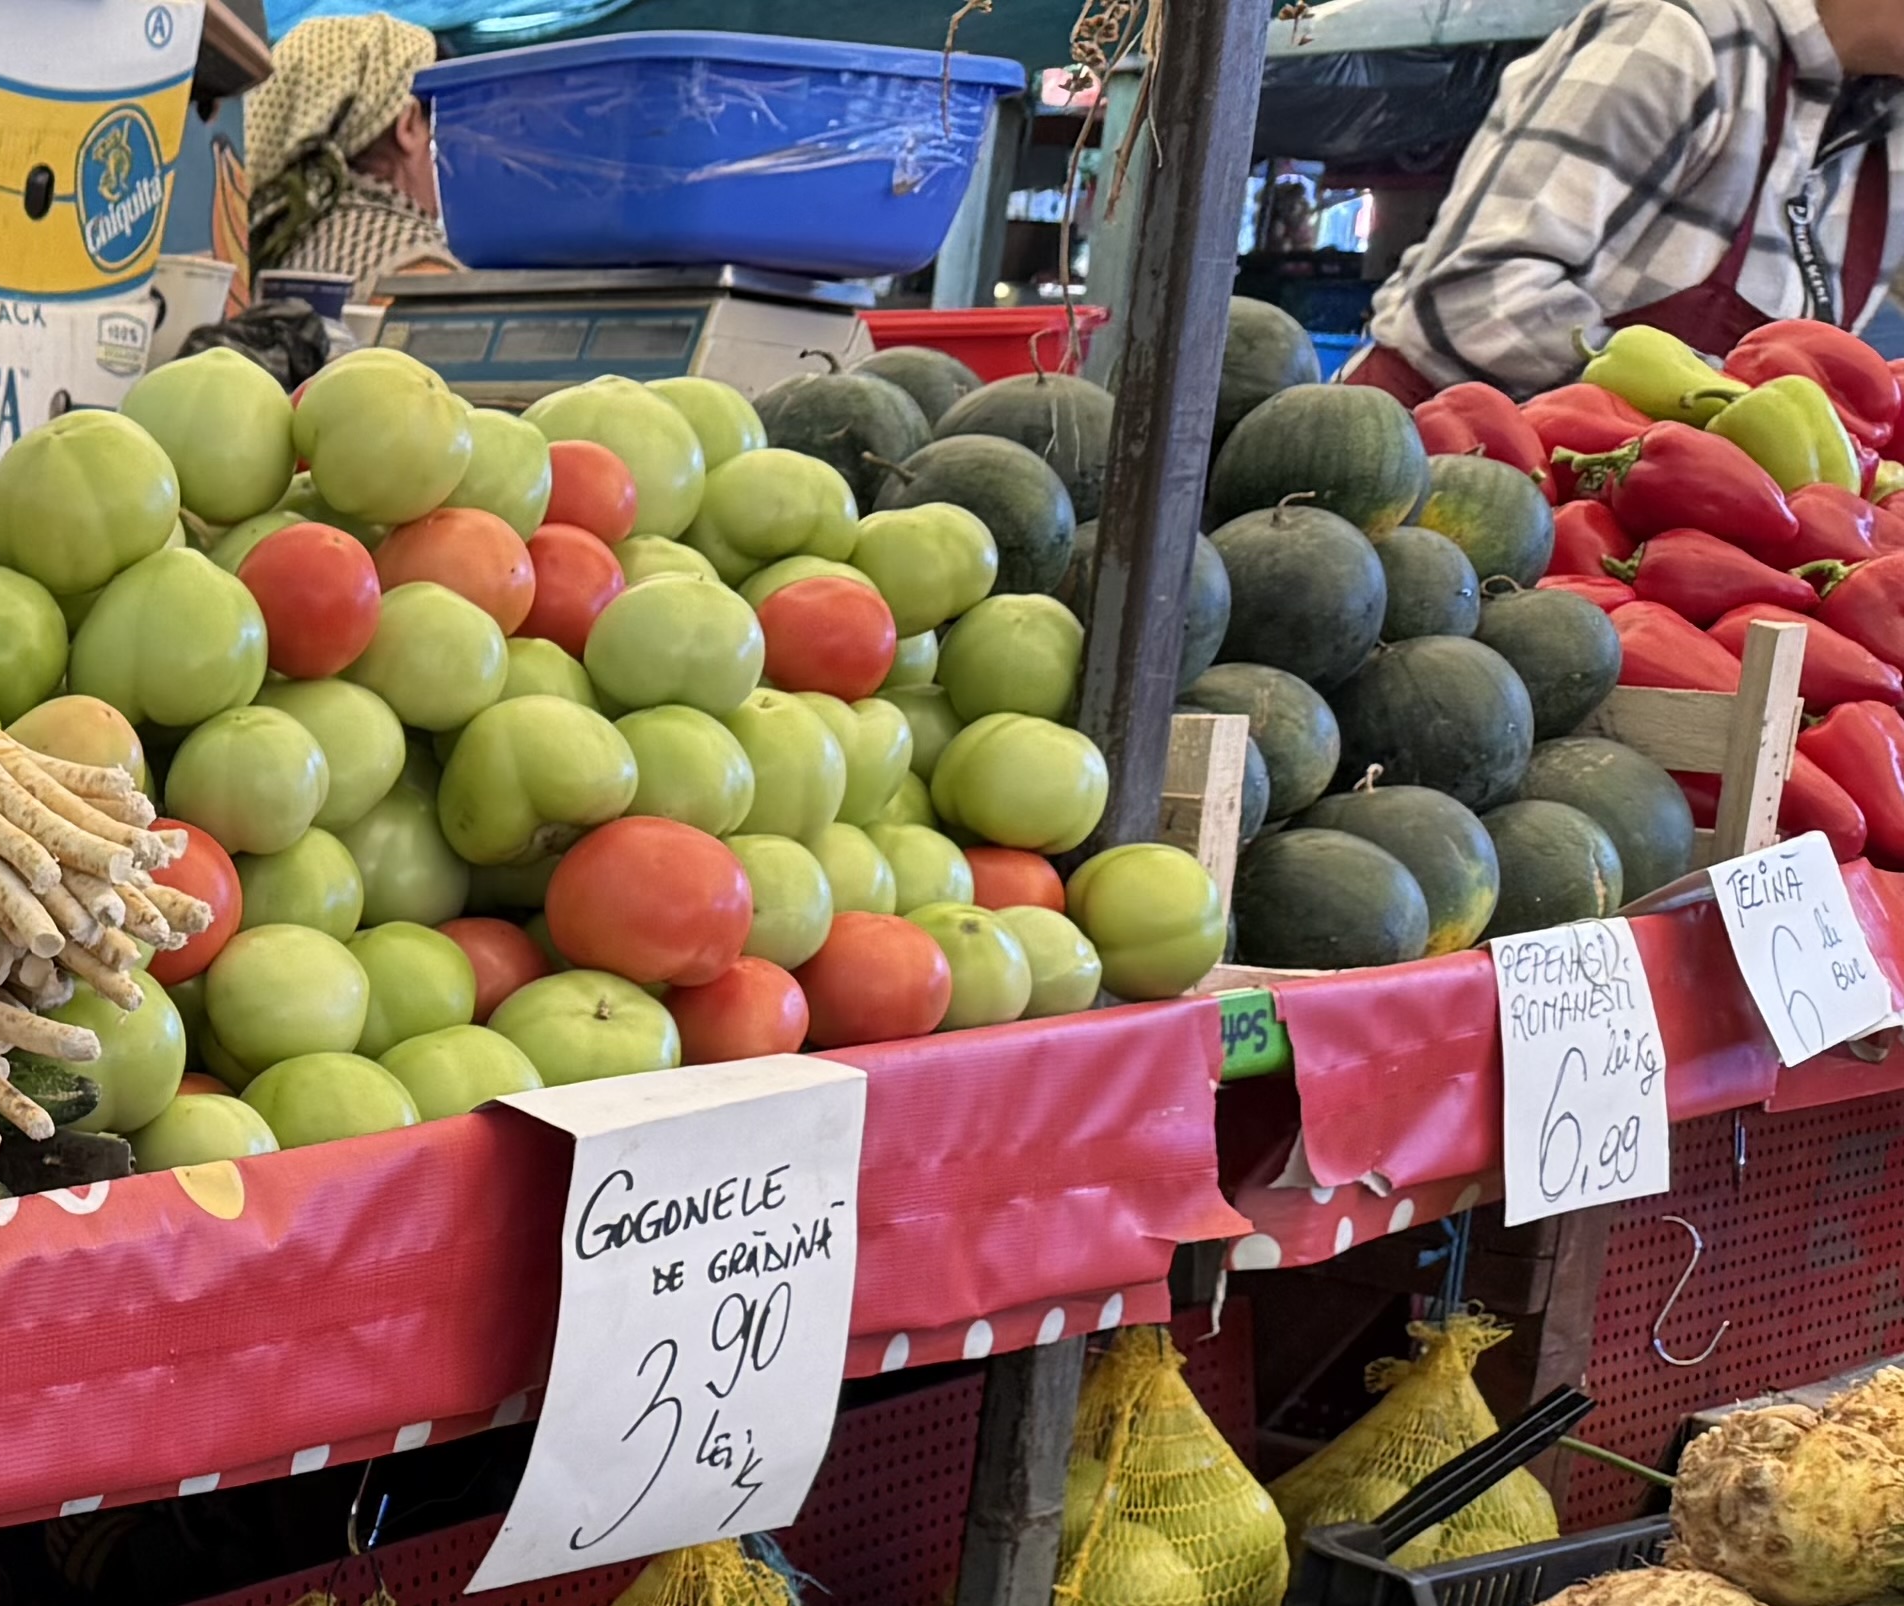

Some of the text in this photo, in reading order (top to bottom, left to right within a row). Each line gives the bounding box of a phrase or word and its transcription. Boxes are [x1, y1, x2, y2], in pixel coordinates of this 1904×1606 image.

[85, 173, 163, 253] Chiquita
[574, 1165, 792, 1262] GOGONELE
[652, 1259, 685, 1296] DE
